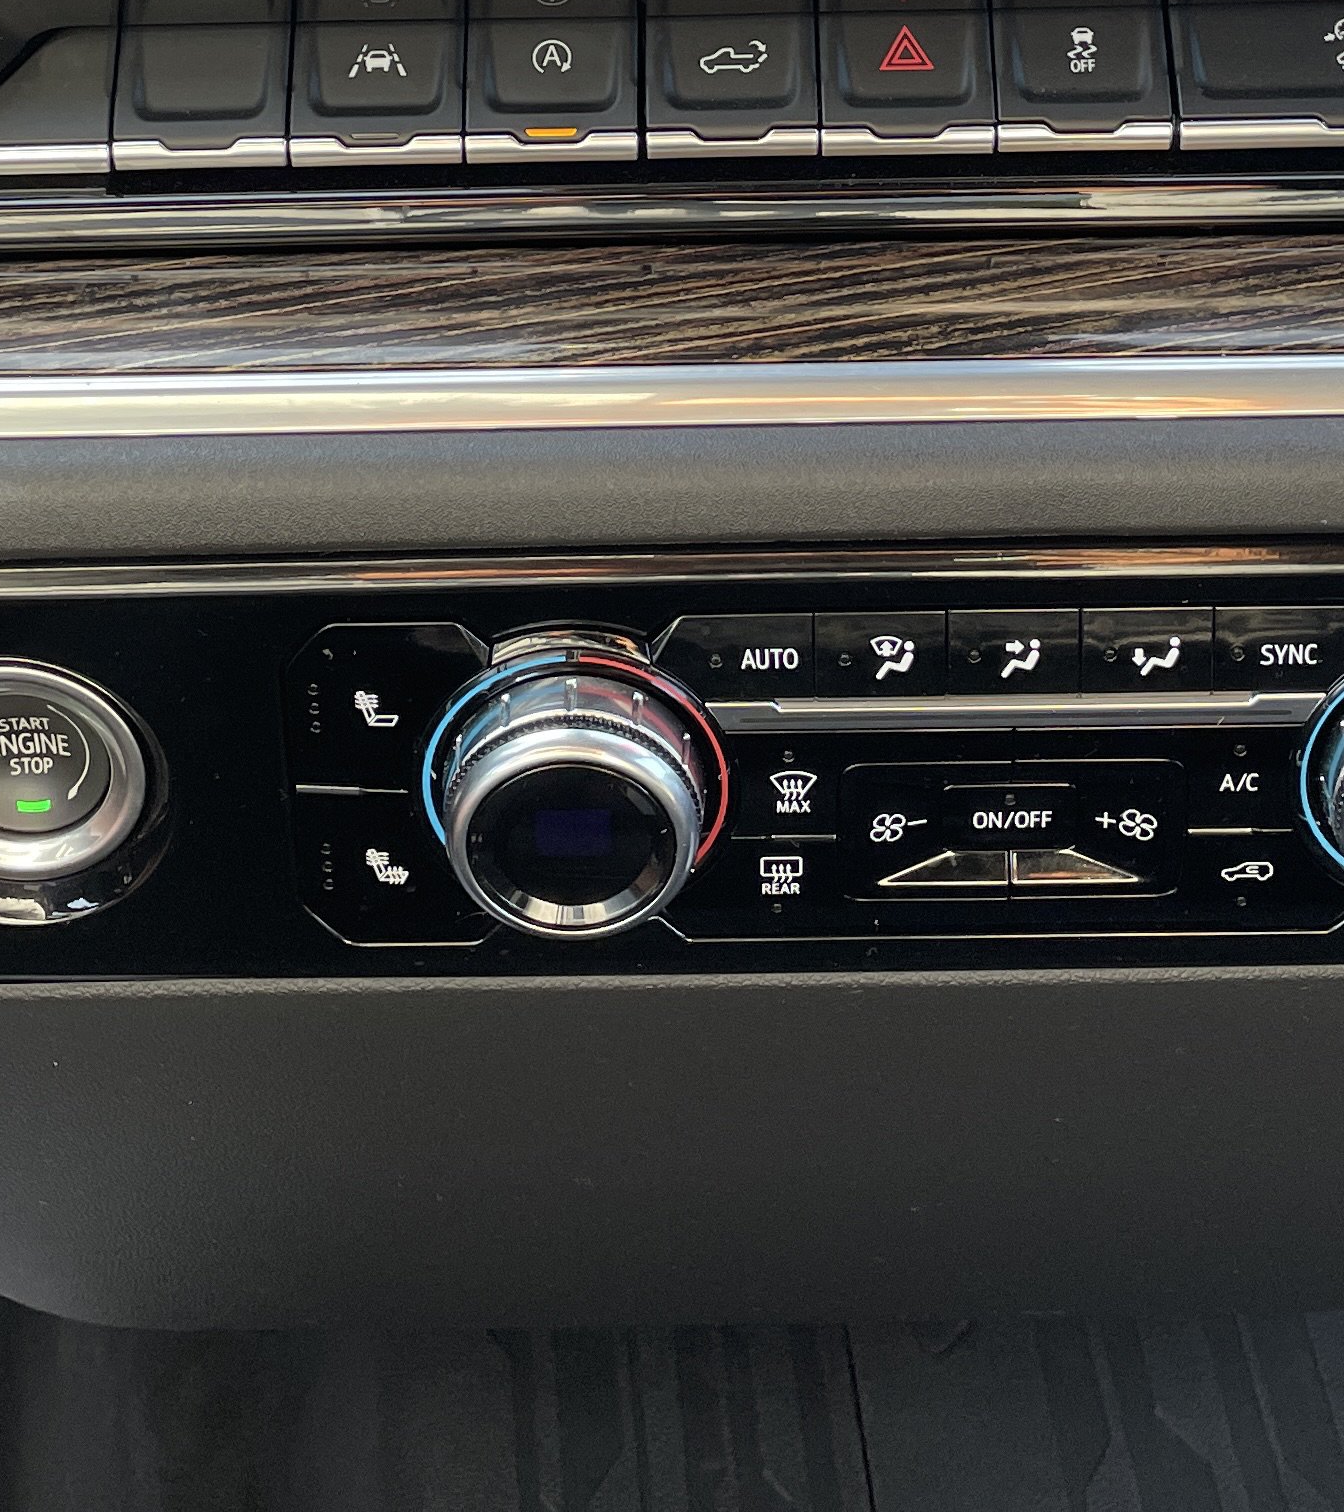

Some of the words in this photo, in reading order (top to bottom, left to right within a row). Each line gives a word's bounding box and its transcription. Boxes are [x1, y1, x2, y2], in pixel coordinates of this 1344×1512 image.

[1070, 58, 1096, 73] OFF
[741, 648, 799, 671] AUTO
[1259, 643, 1319, 666] SYNC
[9, 756, 54, 776] STOP
[1219, 772, 1260, 793] A/C
[776, 799, 811, 814] MAX
[972, 809, 1053, 831] ON/OFF
[761, 881, 800, 896] REAR
